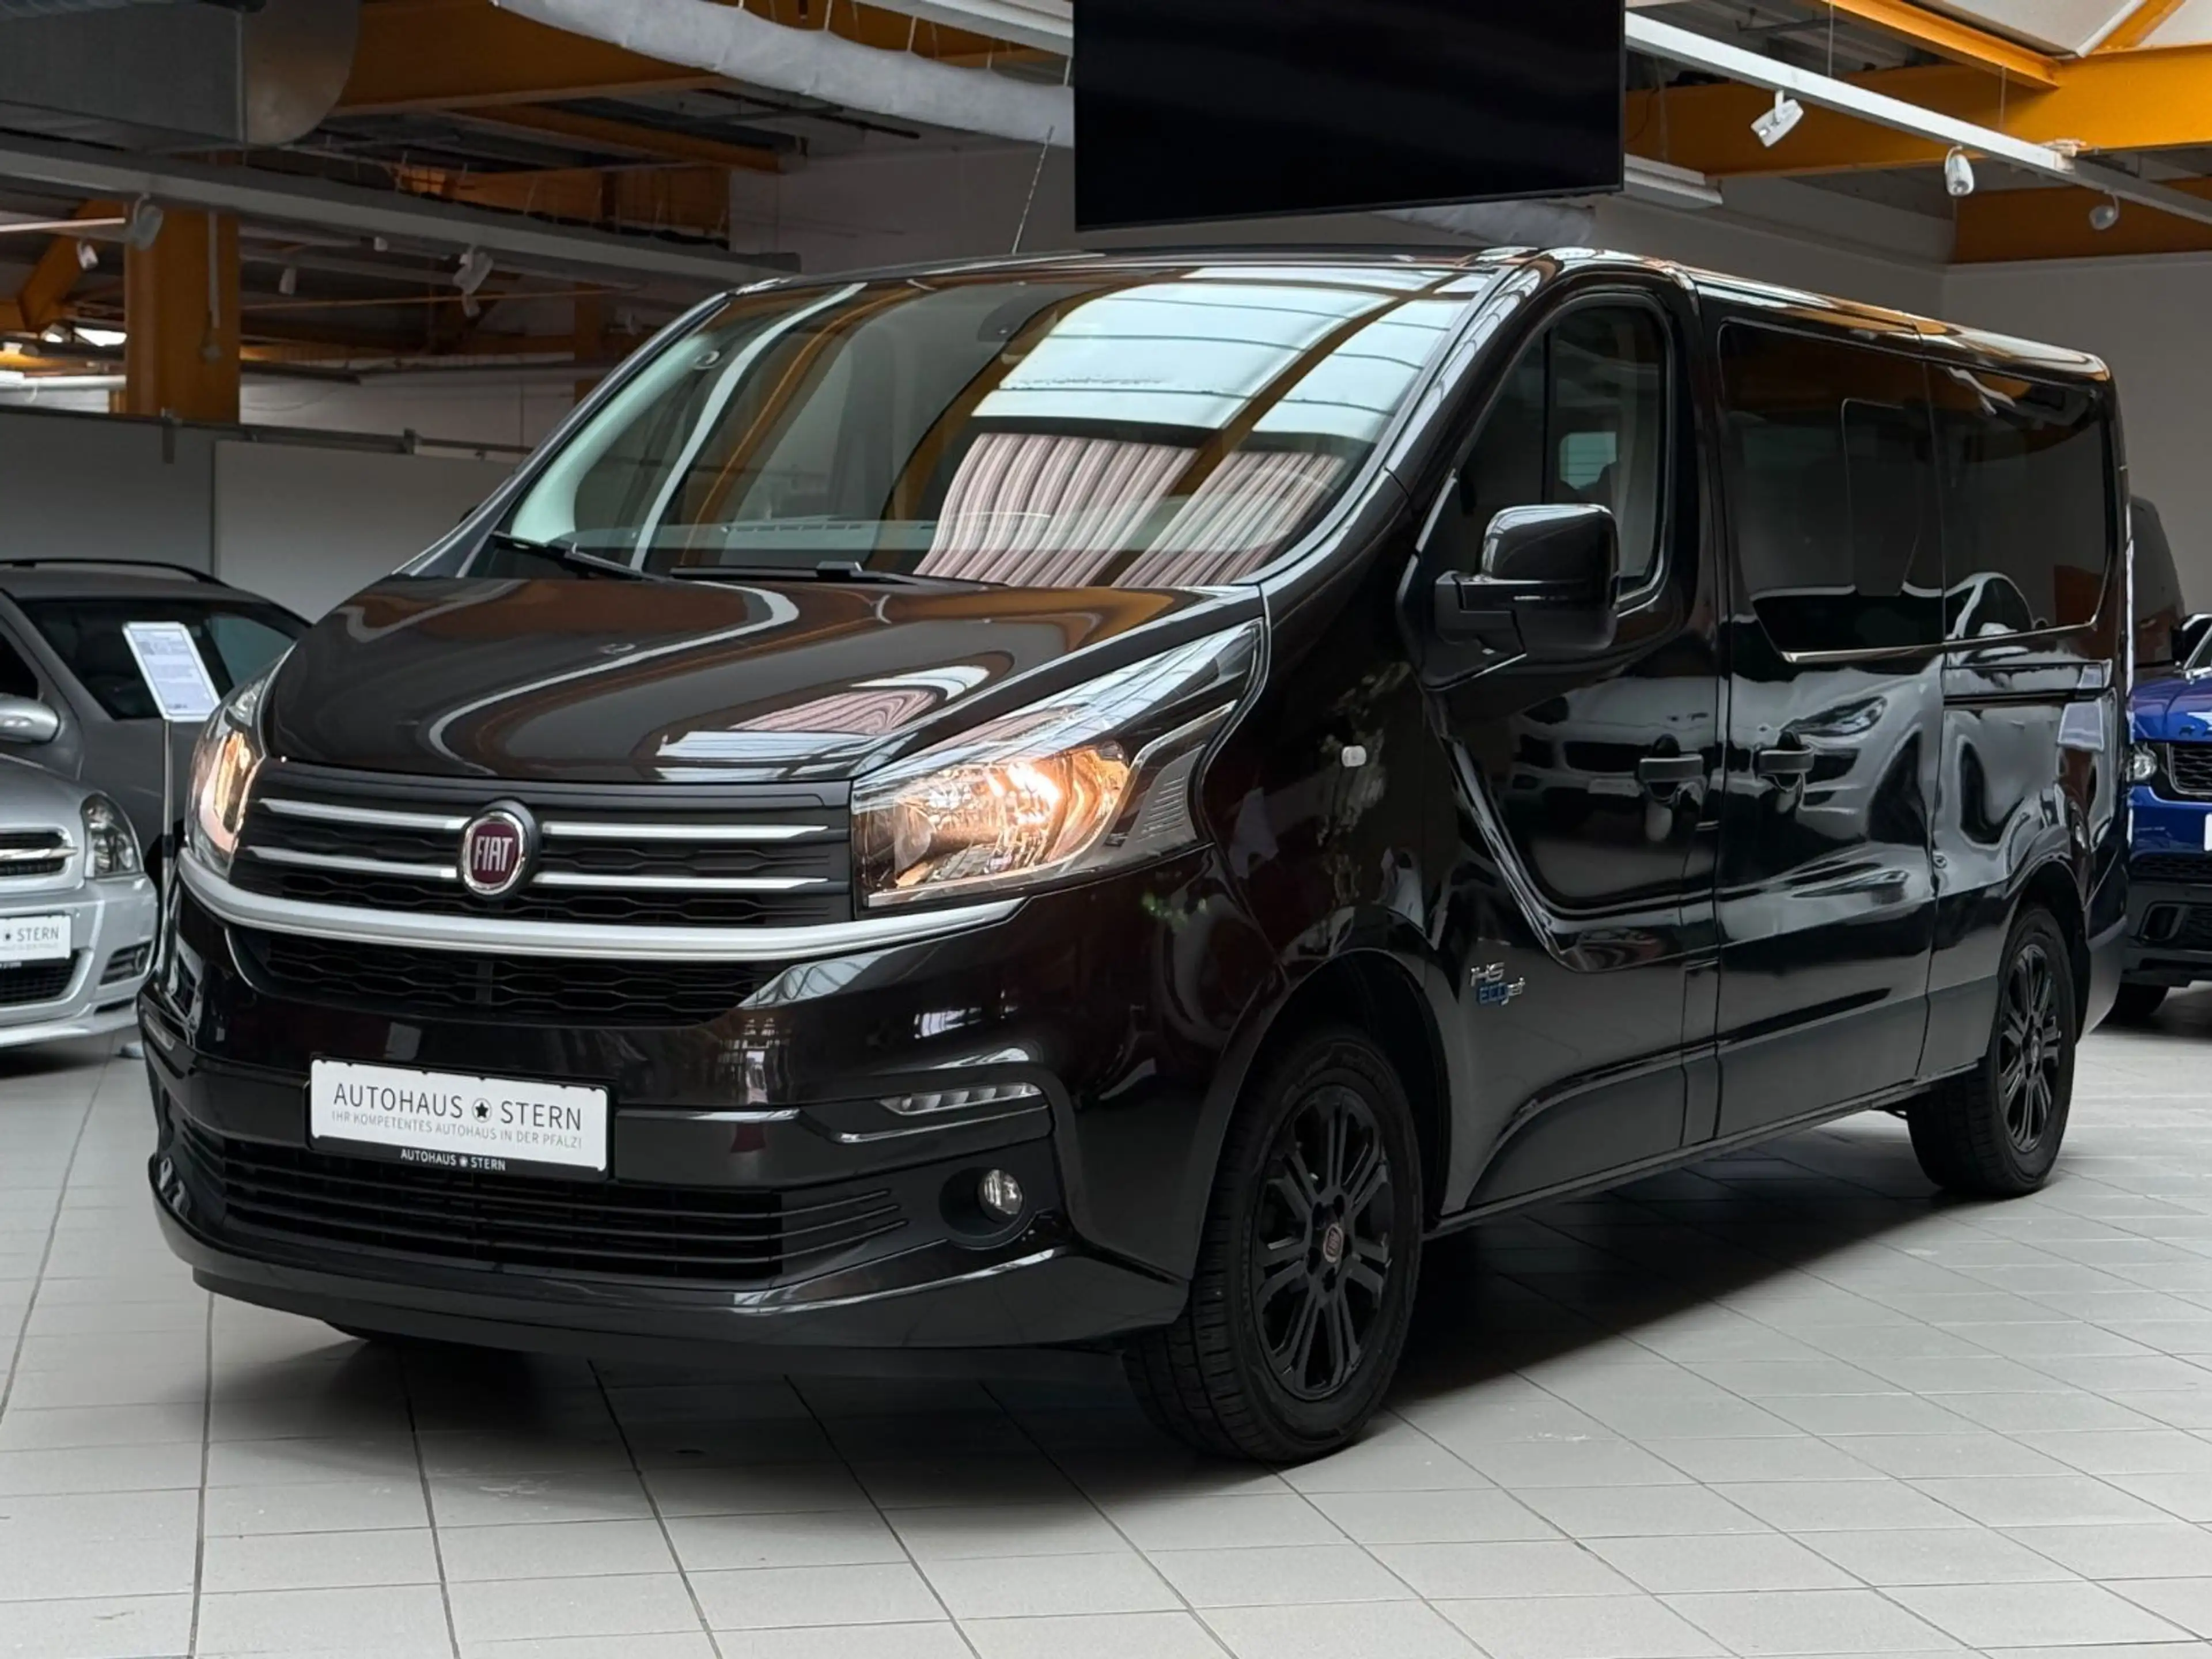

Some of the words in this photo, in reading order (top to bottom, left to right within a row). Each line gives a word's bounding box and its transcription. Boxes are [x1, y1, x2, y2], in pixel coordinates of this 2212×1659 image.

[474, 836, 514, 872] FIAT
[16, 926, 59, 942] STERN
[334, 1082, 463, 1119] AUTOHAUS
[500, 1100, 581, 1131] STERN
[332, 1111, 351, 1123] IHR
[353, 1112, 433, 1133] KOMPETENTES
[435, 1123, 497, 1141] AUTOHAUS
[500, 1130, 512, 1142] IN
[517, 1131, 539, 1145] DER
[400, 1148, 457, 1166] AUTOHAUS
[471, 1157, 506, 1172] STERN
